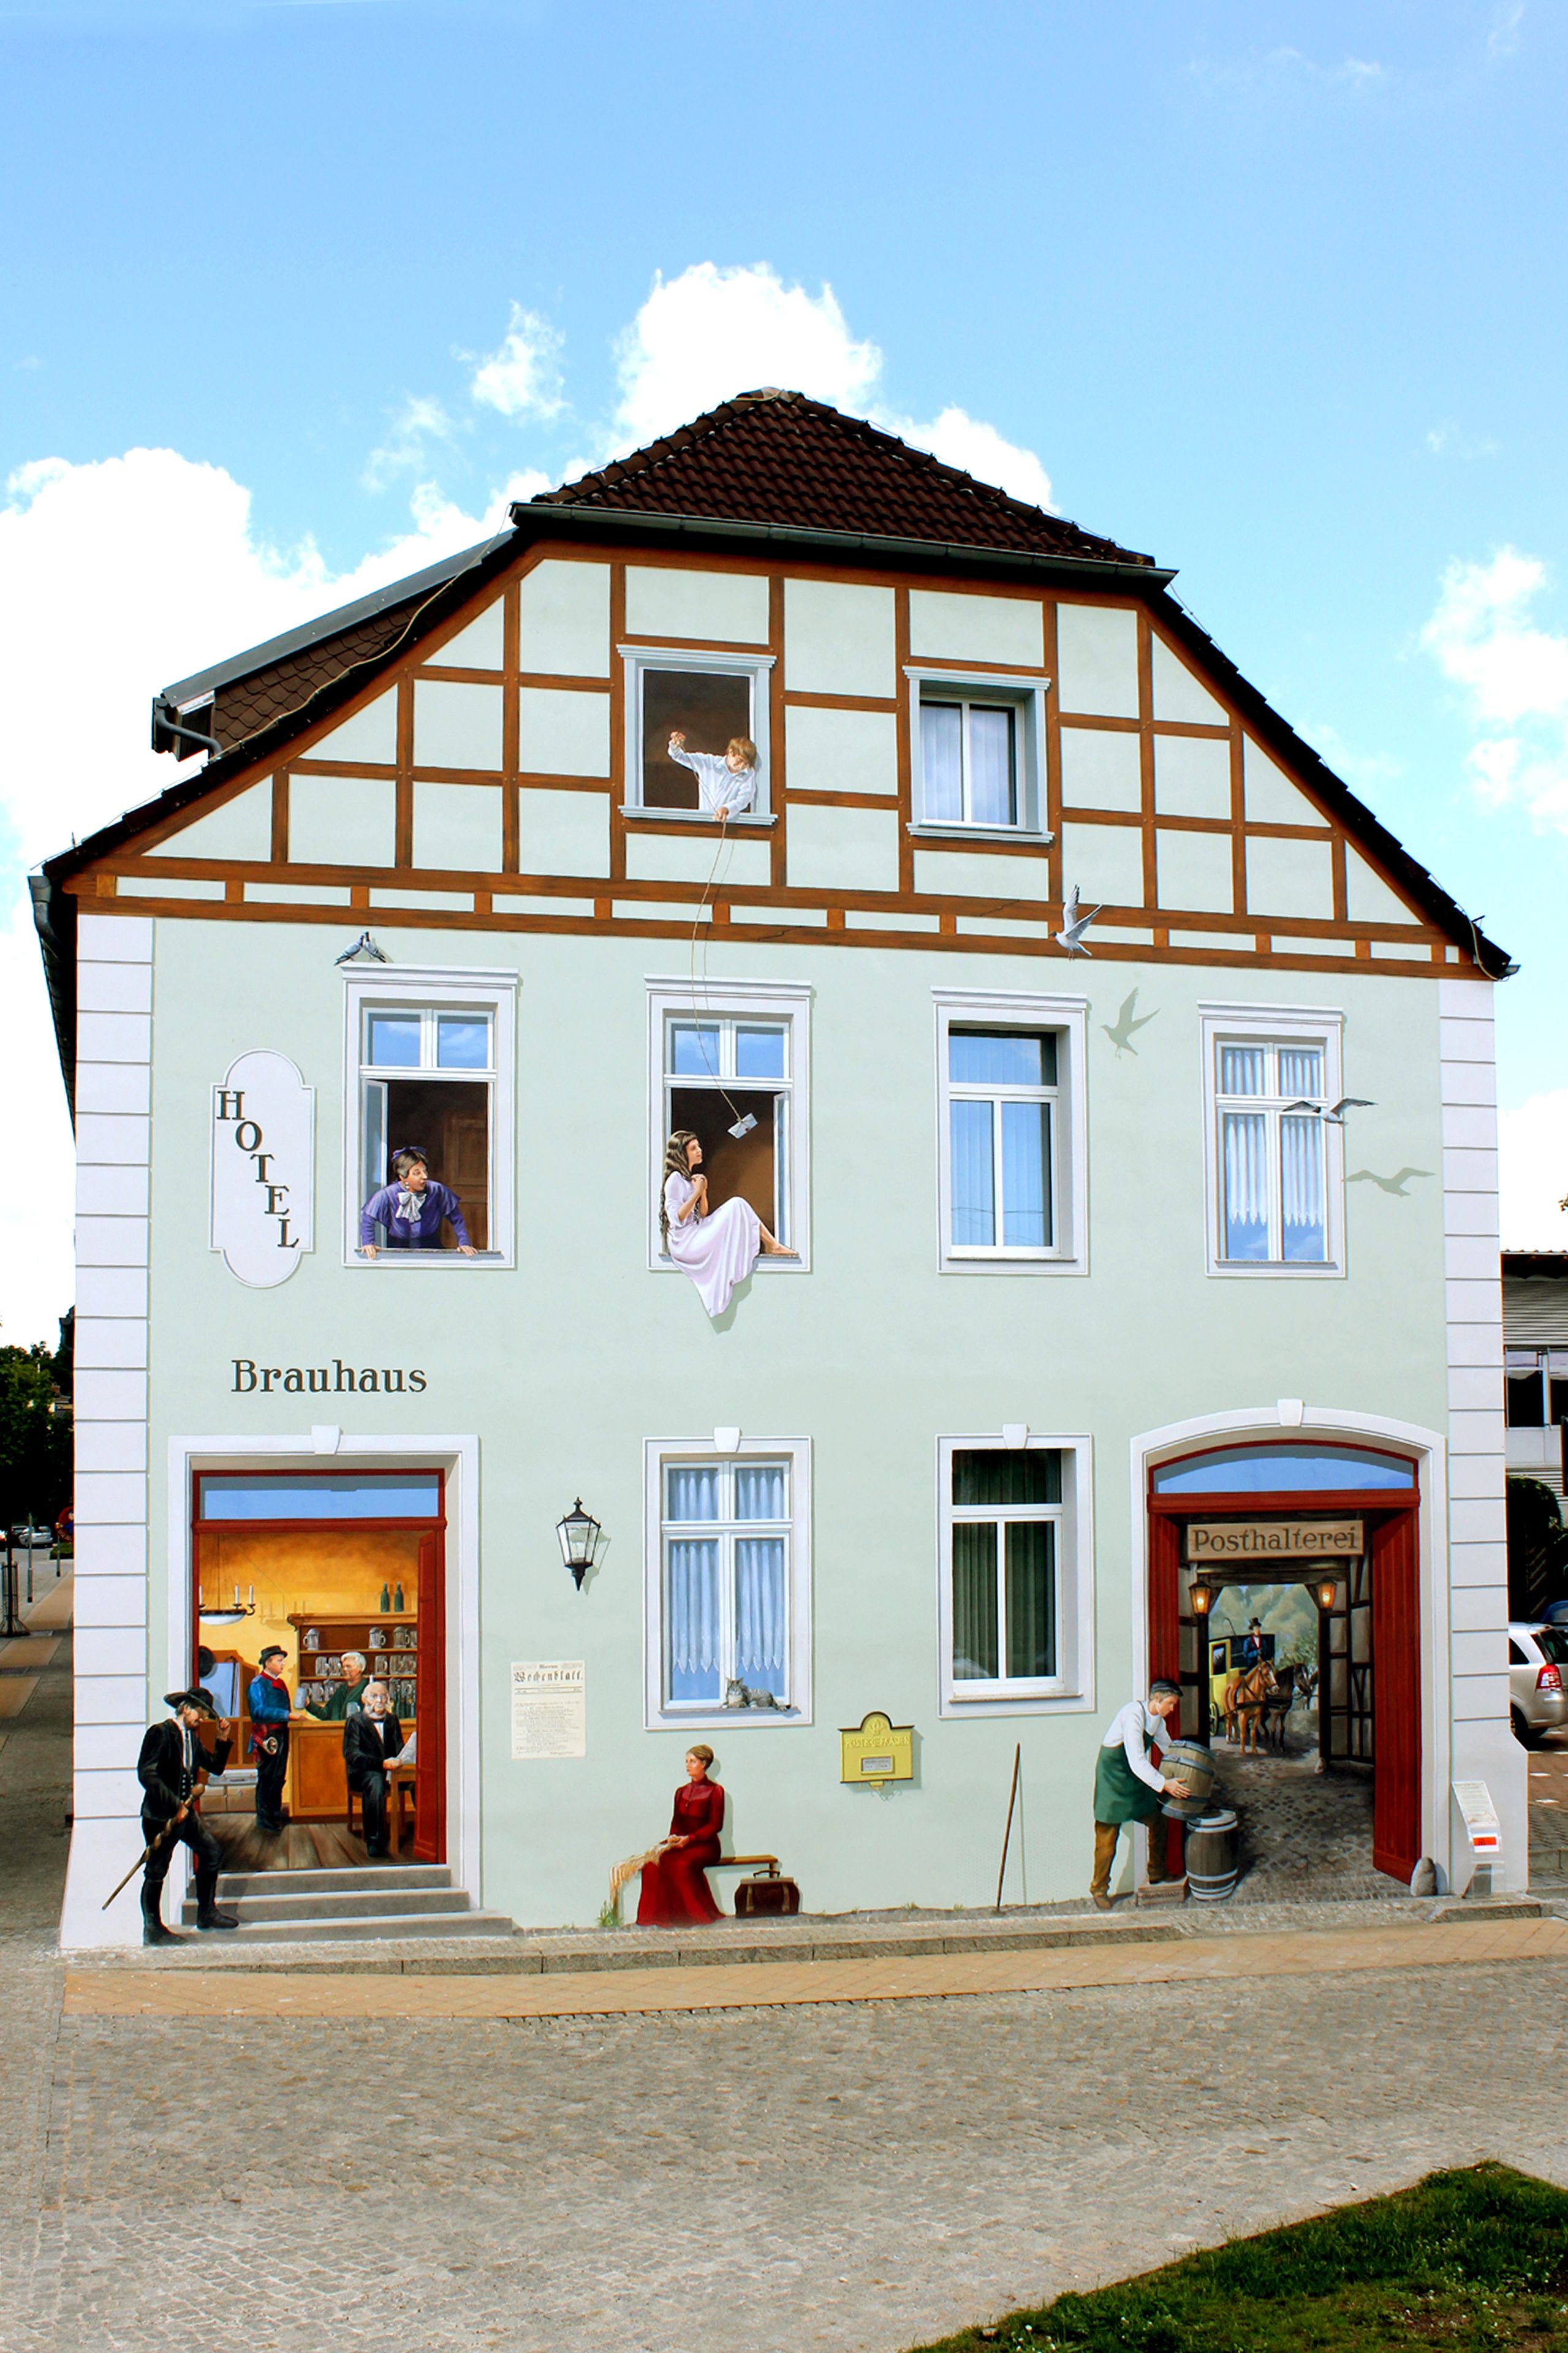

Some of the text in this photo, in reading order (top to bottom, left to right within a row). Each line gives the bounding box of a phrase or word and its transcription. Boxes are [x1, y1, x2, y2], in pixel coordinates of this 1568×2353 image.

[216, 1091, 299, 1248] HOTEL
[231, 1359, 427, 1393] Brauhaus
[1192, 1526, 1357, 1552] Posthalterei
